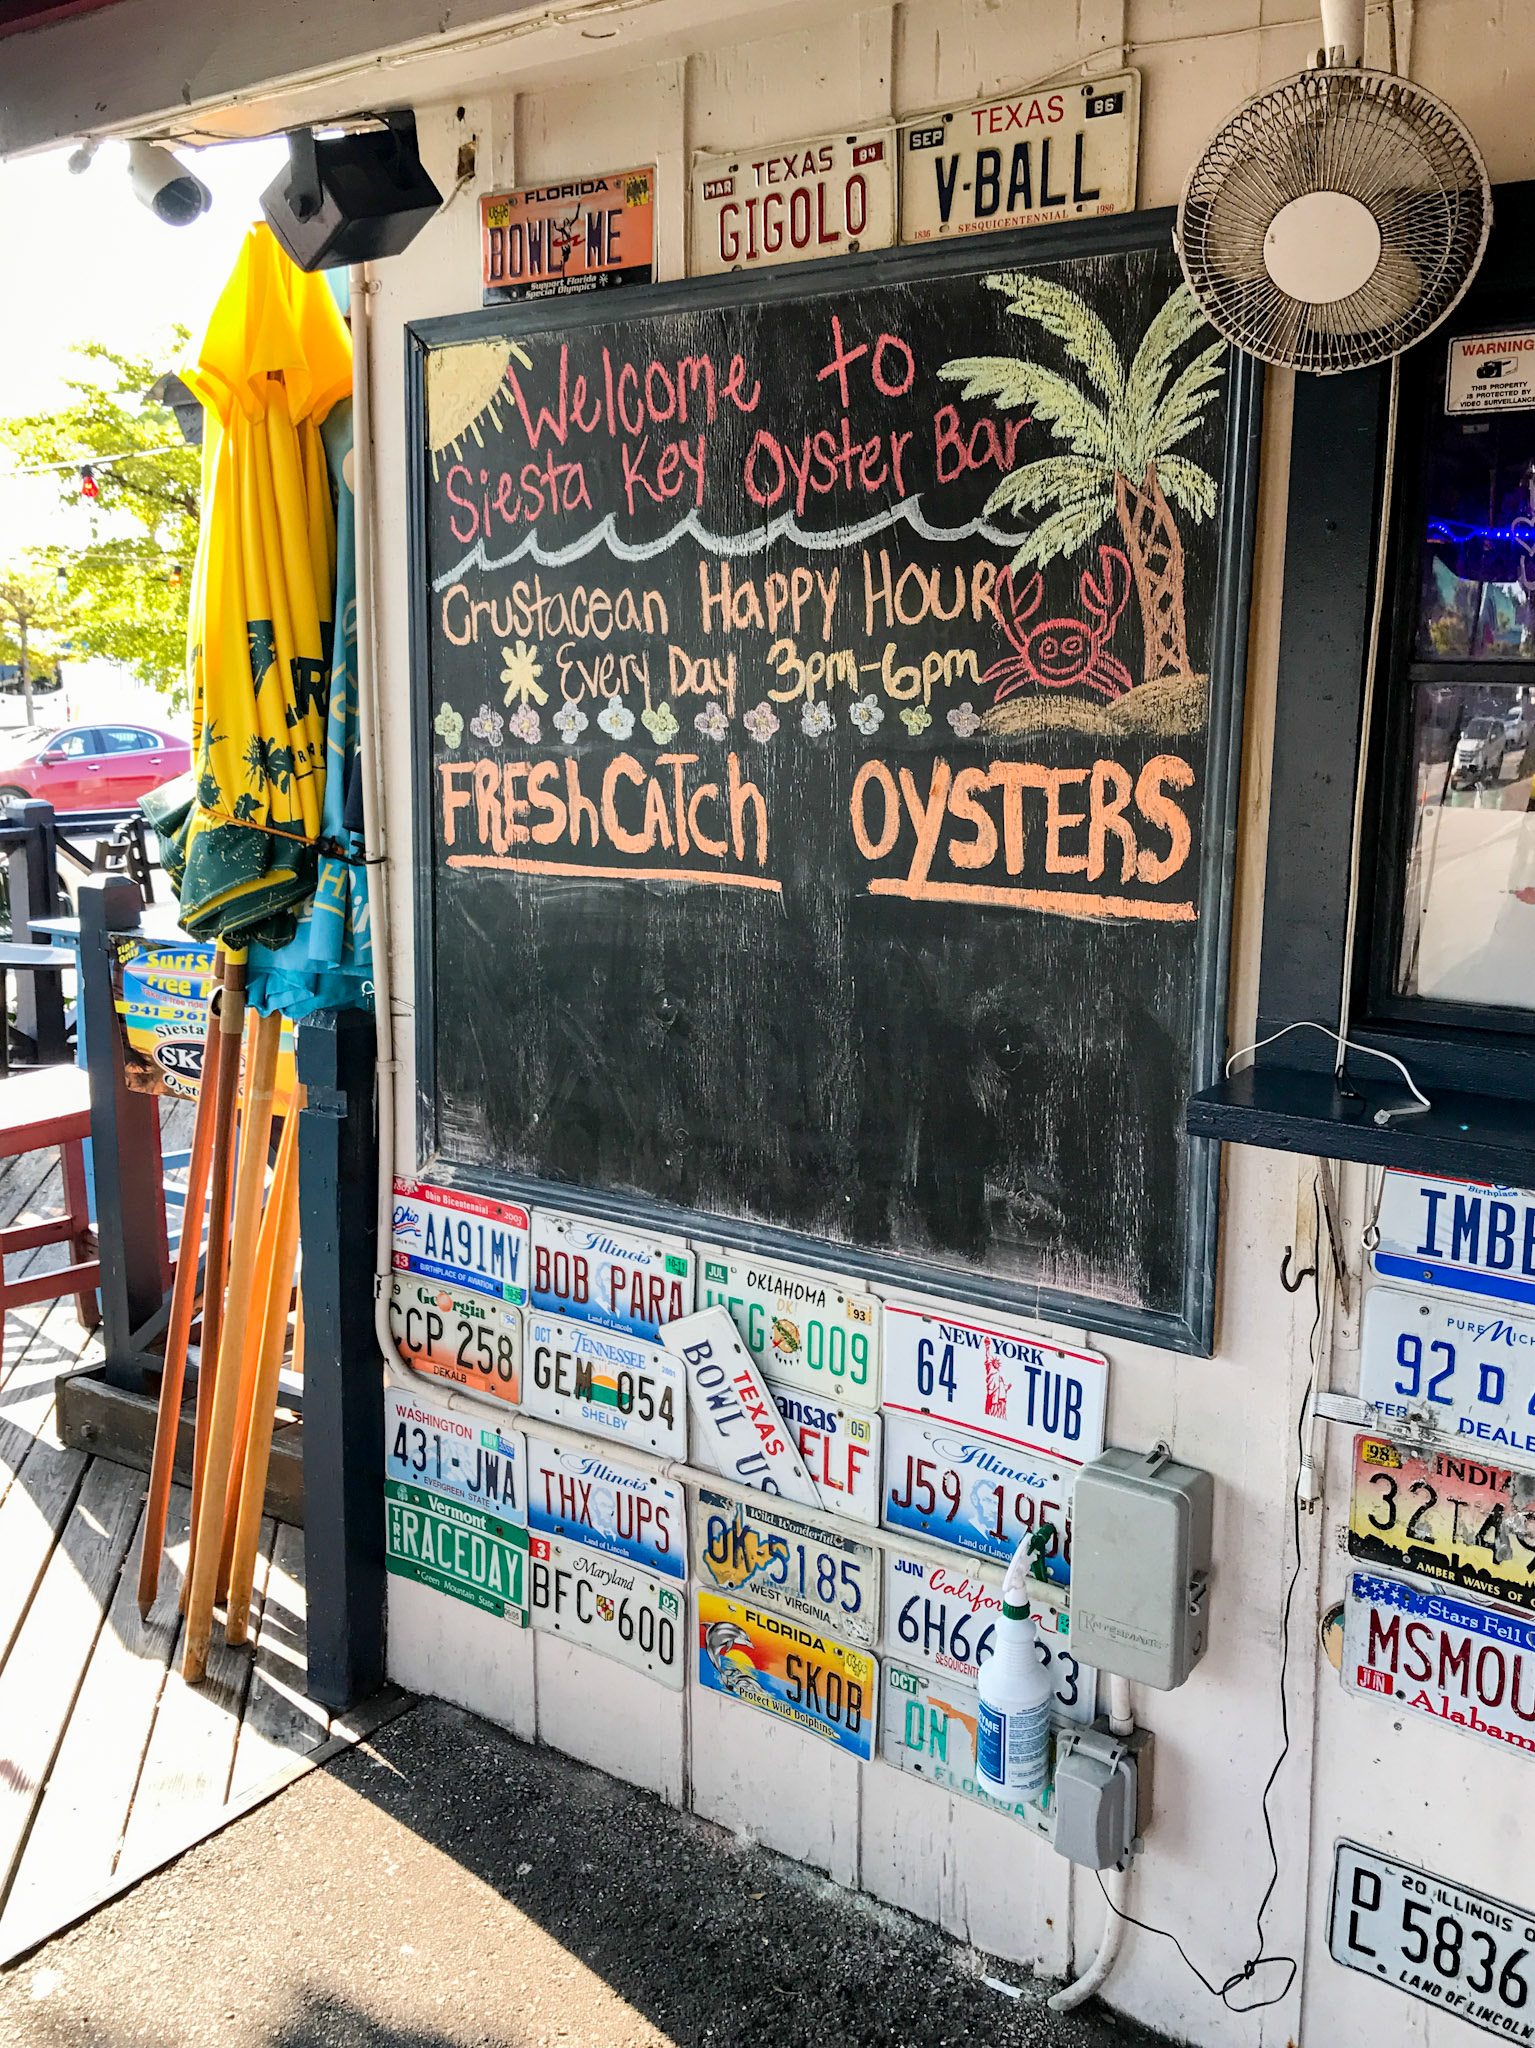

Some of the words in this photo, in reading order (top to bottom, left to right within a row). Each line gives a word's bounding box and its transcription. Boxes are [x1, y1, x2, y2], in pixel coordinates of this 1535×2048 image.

[972, 96, 1064, 135] TEXAS
[1094, 98, 1114, 113] 86
[859, 146, 876, 162] 84
[911, 128, 943, 148] SEP
[752, 147, 833, 187] TEXAS
[935, 132, 1100, 222] V-BALL
[525, 180, 609, 205] FLORIDA
[705, 181, 733, 198] MAR
[720, 174, 866, 262] GIGOLO
[958, 209, 1068, 234] SESQUICENTENNIAL
[488, 219, 562, 282] BOWL
[585, 209, 622, 269] ME
[525, 288, 556, 300] Special
[557, 281, 597, 298] Olympics
[531, 279, 565, 292] Support
[567, 275, 597, 287] Florida
[1462, 339, 1534, 356] WARNING
[508, 344, 760, 449] Welcome
[817, 315, 914, 408] to
[1476, 390, 1518, 398] PROTECTED
[1490, 382, 1528, 390] PROPERTY
[447, 449, 592, 544] Siesta
[622, 434, 705, 515] Key
[744, 418, 913, 517] Oyster
[934, 404, 1031, 484] Bar
[442, 573, 668, 646] Crustacean
[699, 561, 840, 642] Happy
[864, 550, 1000, 636] HOUR
[556, 641, 652, 711] Every
[668, 645, 736, 718] Day
[767, 638, 983, 706] 3pm-6pm
[850, 754, 1196, 885] OYSTERS
[117, 940, 135, 956] Tips
[118, 946, 140, 964] Only
[142, 987, 160, 1001] Take
[155, 1024, 205, 1038] Siesta
[162, 1048, 204, 1070] SK
[425, 1190, 441, 1203] Ohio
[443, 1194, 489, 1215] Bicentennial
[504, 1212, 523, 1226] 2003
[1468, 1185, 1519, 1198] Birthplace
[393, 1206, 419, 1225] Ohio
[393, 1254, 410, 1267] 43
[565, 1229, 652, 1264] Illinois
[420, 1263, 457, 1279] BIRTHPLACE
[458, 1274, 467, 1282] OF
[467, 1278, 493, 1291] AVIATION
[535, 1246, 589, 1304] BOB
[610, 1265, 683, 1325] PARA
[708, 1265, 725, 1279] JUL
[746, 1271, 826, 1308] OKLAHOMA
[417, 1287, 486, 1319] Georgia
[853, 1309, 866, 1321] 93
[535, 1326, 551, 1344] OCT
[588, 1313, 603, 1325] Land
[604, 1318, 610, 1326] of
[610, 1321, 633, 1334] Lincoln
[1447, 1318, 1485, 1334] PURE
[457, 1321, 513, 1382] 258
[570, 1330, 646, 1370] TENNESSEE
[807, 1320, 869, 1385] 009
[938, 1325, 984, 1350] NEW
[989, 1338, 1045, 1367] YORK
[433, 1366, 467, 1384] DEKALB
[1394, 1333, 1455, 1406] 92
[1477, 1363, 1505, 1405] D
[535, 1347, 593, 1403] GEM
[617, 1371, 674, 1431] 054
[682, 1338, 746, 1437] BOWL
[917, 1338, 957, 1403] 64
[1024, 1366, 1083, 1441] TUB
[396, 1404, 472, 1440] WASHINGTON
[582, 1406, 628, 1430] SHELBY
[733, 1370, 785, 1456] TEXAS
[771, 1395, 837, 1433] ansas
[1374, 1401, 1408, 1418] FEB
[851, 1421, 864, 1439] 05
[932, 1438, 1048, 1488] Illinois
[1369, 1445, 1391, 1462] 98
[560, 1454, 649, 1491] Illinois
[891, 1456, 961, 1522] J59
[424, 1476, 465, 1497] EVERGREEN
[468, 1493, 490, 1507] STATE
[428, 1495, 487, 1530] Vermont
[540, 1468, 593, 1528] THX
[616, 1491, 670, 1553] UPS
[584, 1535, 598, 1547] Land
[599, 1540, 606, 1549] of
[607, 1544, 630, 1557] Lincoln
[778, 1518, 835, 1546] Wonderful
[958, 1535, 978, 1549] Land
[978, 1543, 988, 1551] of
[989, 1546, 1014, 1562] Lincol
[402, 1510, 518, 1598] RACEDAY
[537, 1542, 546, 1558] 3
[573, 1557, 635, 1591] Maryland
[894, 1560, 924, 1578] JUN
[1417, 1562, 1456, 1581] AMBER
[1463, 1576, 1500, 1596] WAVES
[1507, 1591, 1523, 1602] OF
[421, 1571, 440, 1585] Green
[444, 1580, 475, 1600] Mountain
[478, 1595, 495, 1609] State
[662, 1597, 676, 1612] 02
[750, 1583, 781, 1602] WEST
[784, 1596, 831, 1624] VIRGINIA
[533, 1563, 593, 1624] BFC
[618, 1598, 674, 1665] 600
[745, 1610, 826, 1653] FLORIDA
[1428, 1600, 1479, 1629] Stars
[1482, 1615, 1521, 1643] Fell
[786, 1653, 862, 1733] SKOB
[891, 1671, 916, 1692] OCT
[739, 1686, 769, 1707] Protect
[772, 1700, 791, 1716] Wild
[794, 1709, 832, 1736] Dolphins
[1402, 1875, 1427, 1895] 20
[1437, 1890, 1514, 1932] ILLINOIS
[1401, 1899, 1529, 2008] 5836
[1399, 1970, 1442, 1997] LAND
[1445, 1990, 1466, 2005] OF
[1466, 2001, 1534, 2040] LINCOLN
